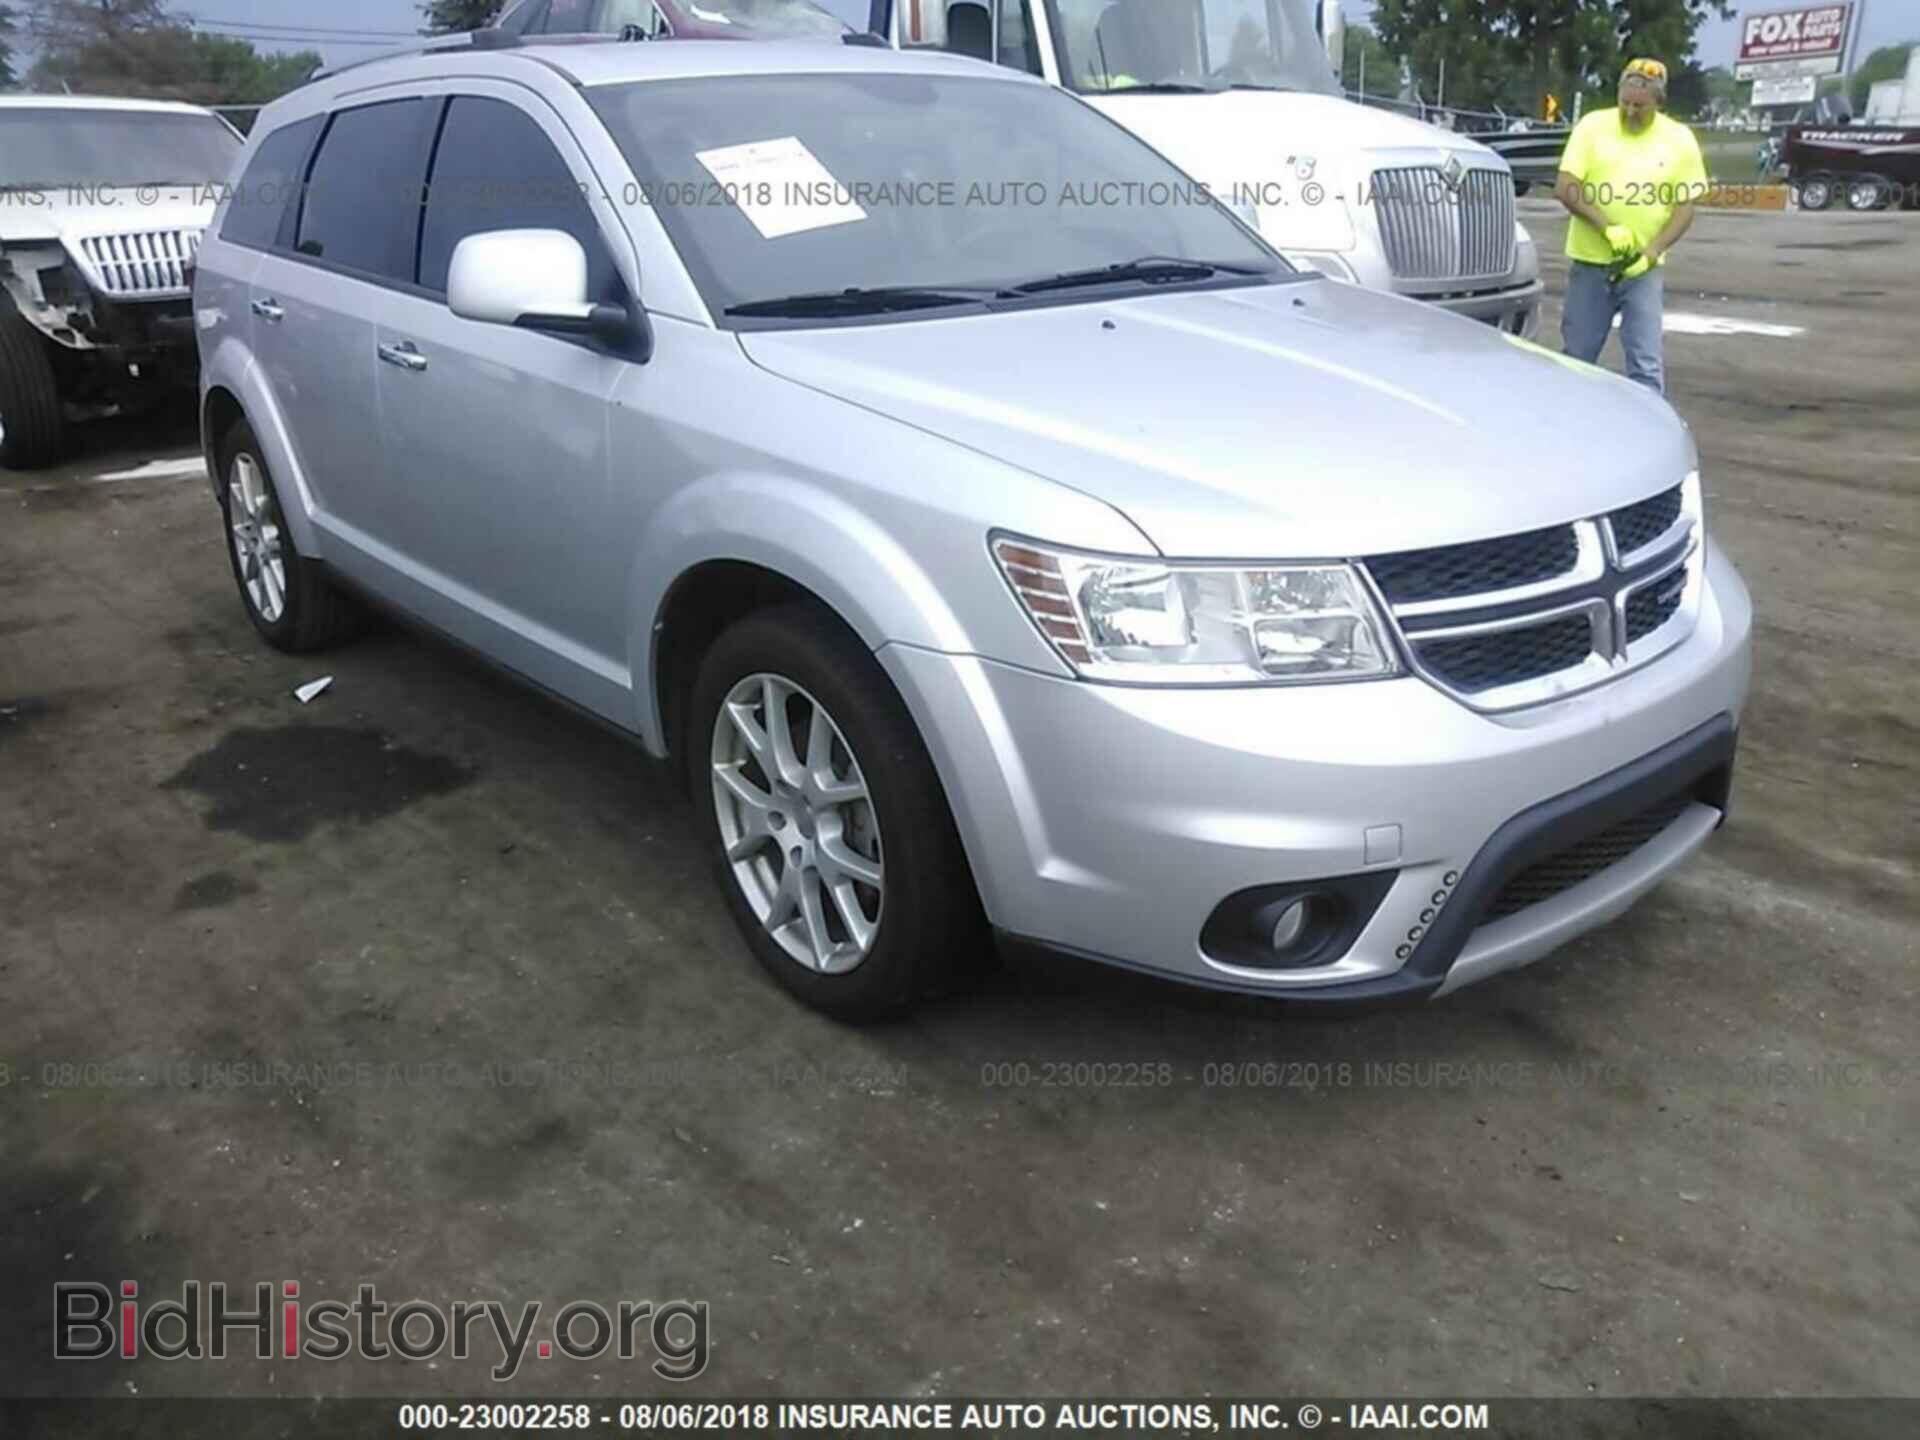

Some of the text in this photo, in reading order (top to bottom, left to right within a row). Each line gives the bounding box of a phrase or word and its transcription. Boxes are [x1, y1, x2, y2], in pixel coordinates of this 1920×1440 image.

[1744, 8, 1840, 44] FOX AUTO
[1803, 22, 1840, 39] PARTS
[1801, 131, 1905, 142] TRACKER
